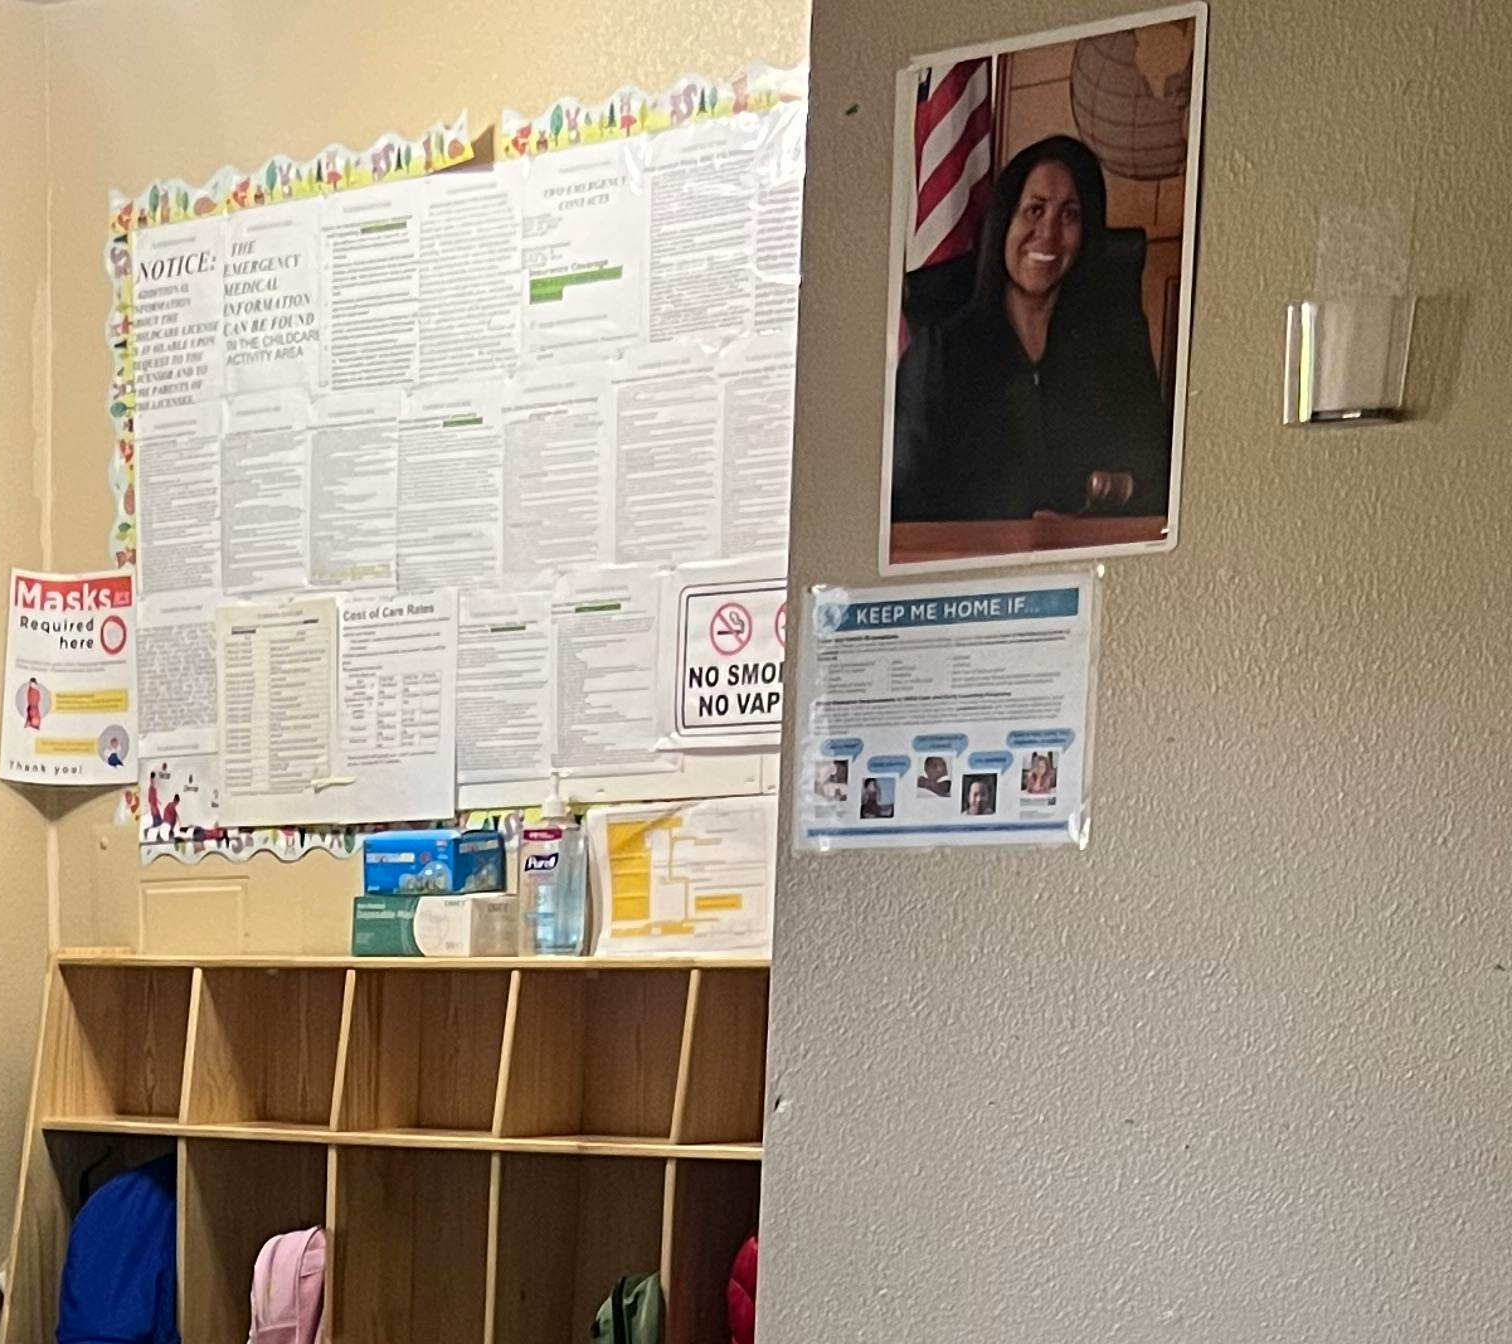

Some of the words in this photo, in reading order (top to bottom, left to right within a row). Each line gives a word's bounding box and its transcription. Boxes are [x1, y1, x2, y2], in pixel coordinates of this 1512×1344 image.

[231, 240, 256, 257] THE
[136, 251, 217, 284] NOTICE:
[223, 254, 302, 278] EMERGENCY
[224, 277, 278, 297] MEDICAL
[223, 294, 311, 317] INFORMATION
[223, 321, 247, 337] CAN
[251, 318, 268, 333] BE
[270, 312, 315, 330] FOUND
[239, 337, 260, 349] THE
[226, 350, 272, 366] ACTIVITY
[274, 346, 304, 360] AREA
[17, 580, 112, 613] Masks
[856, 606, 905, 625] KEEP
[910, 602, 937, 620] ME
[943, 598, 1001, 618] HOME
[20, 616, 94, 634] Required
[59, 637, 94, 650] here
[689, 666, 719, 688] NO
[699, 694, 729, 717] NO
[737, 691, 780, 715] VAP
[8, 760, 46, 773] Thank
[54, 765, 83, 776] you!
